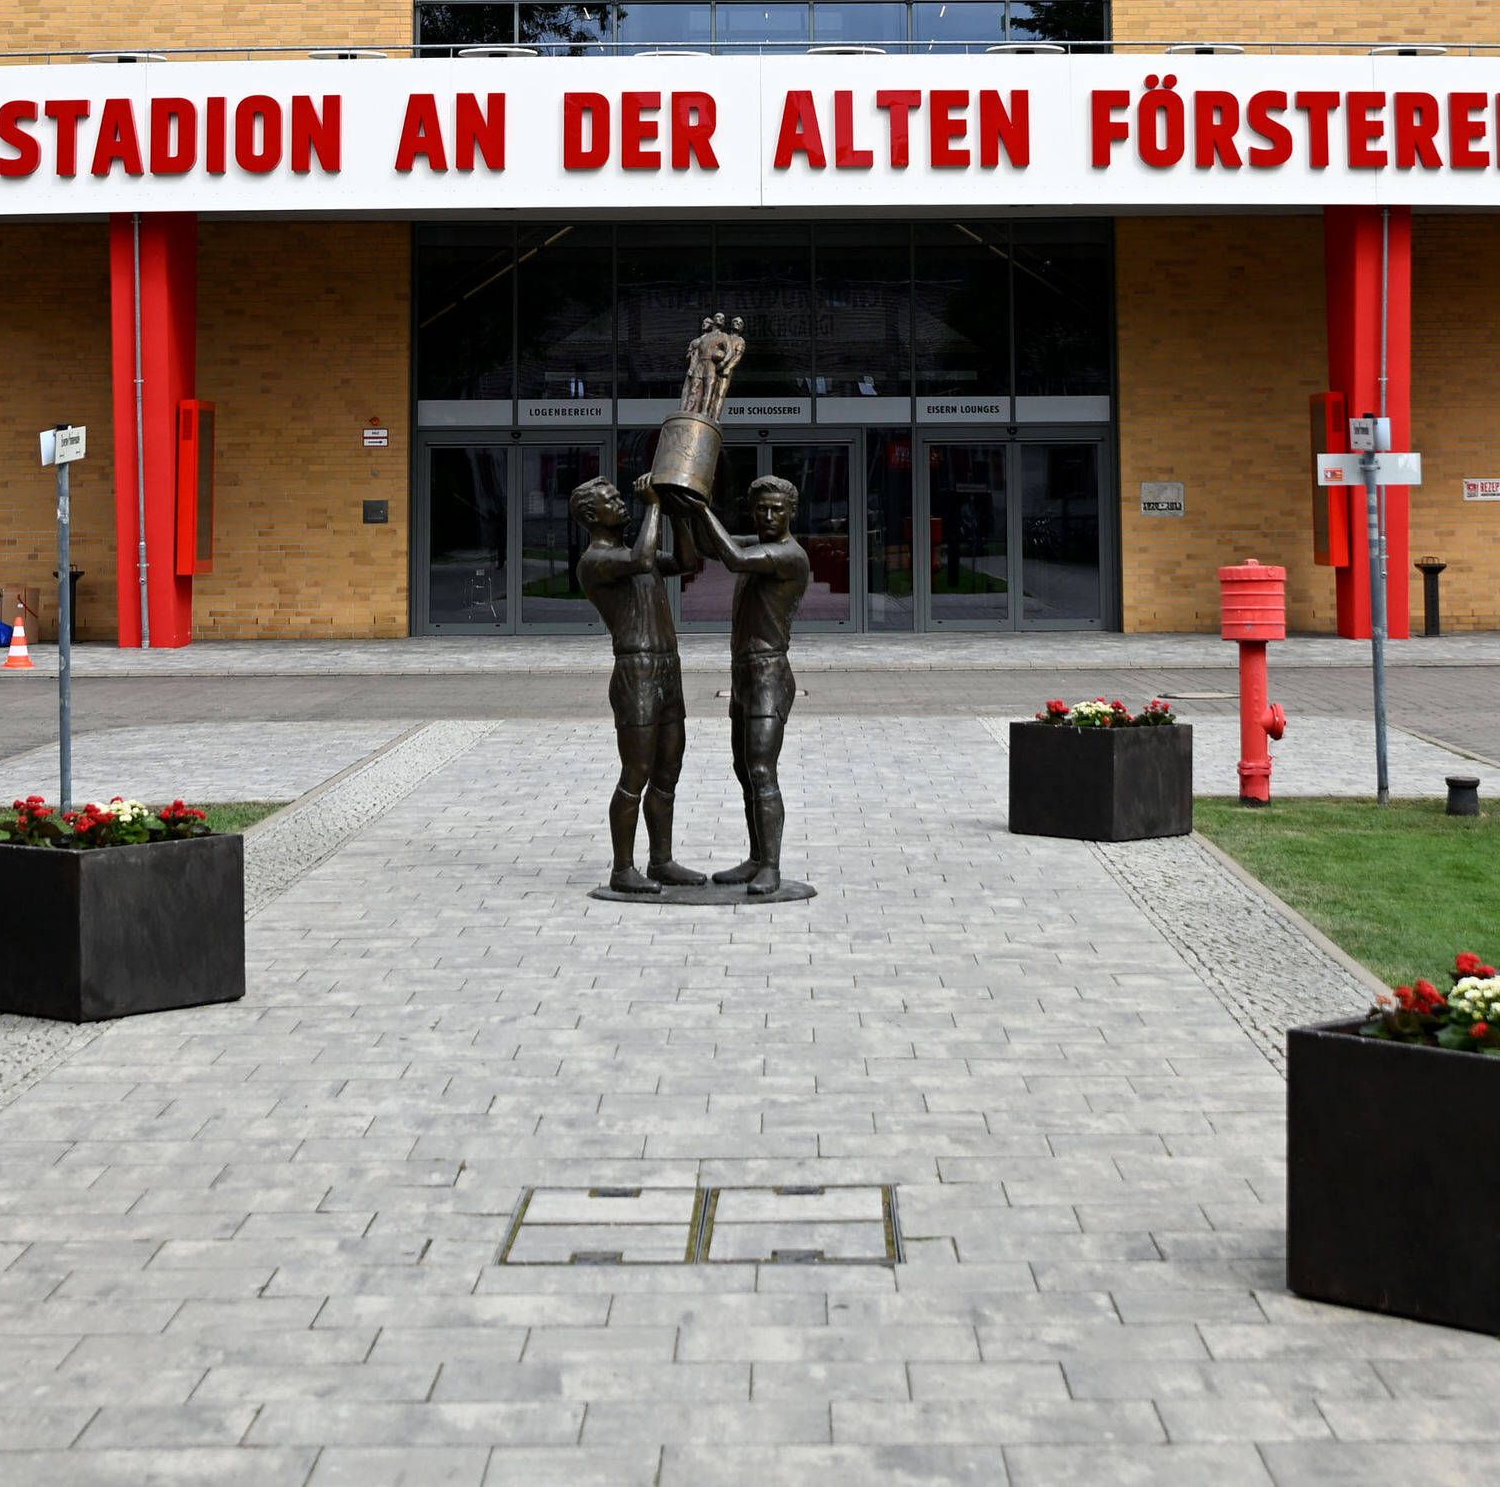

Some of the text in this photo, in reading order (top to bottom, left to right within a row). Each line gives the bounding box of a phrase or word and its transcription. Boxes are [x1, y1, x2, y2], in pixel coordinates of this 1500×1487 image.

[394, 91, 506, 173] AN
[562, 91, 721, 172] DER
[772, 89, 1031, 171] ALTEN
[528, 407, 602, 417] LOGENBEREICH
[728, 406, 801, 415] ZUR SCHLOSSEREI
[927, 405, 1000, 414] EISERN LOUNGES
